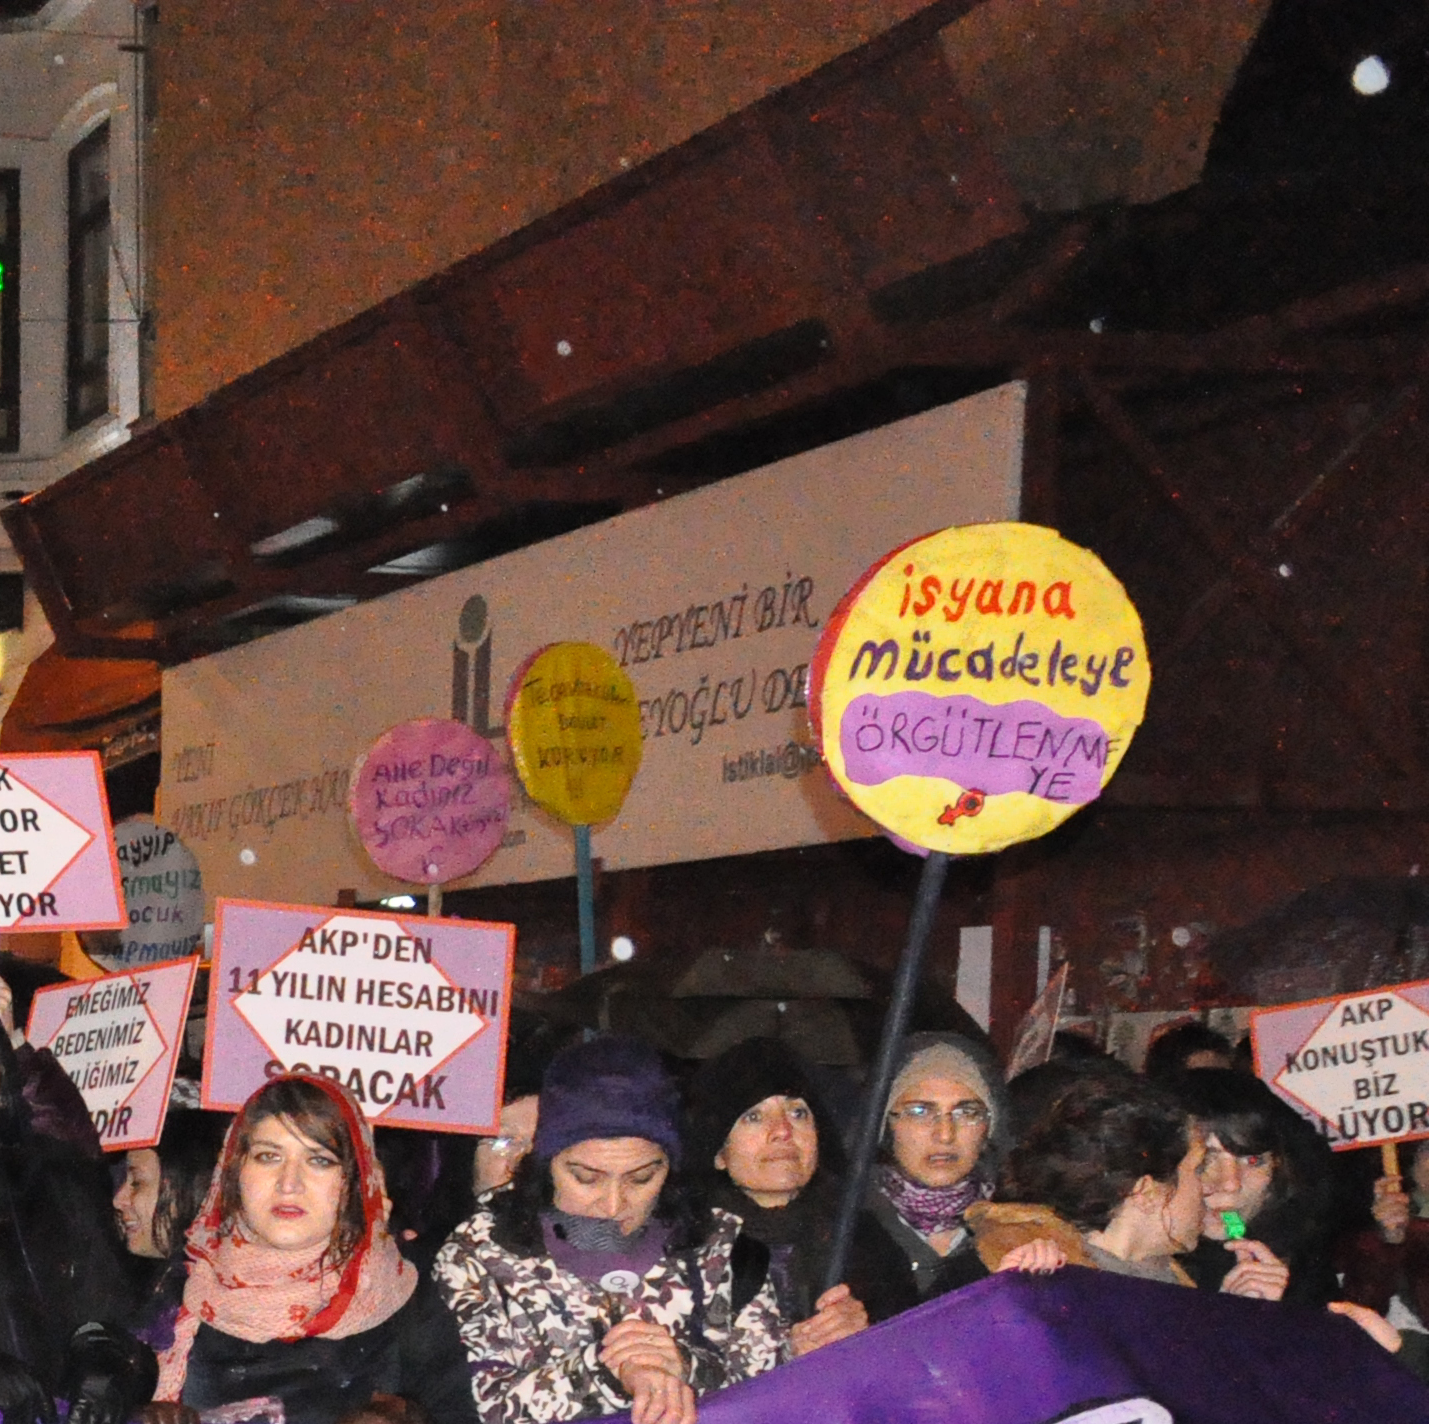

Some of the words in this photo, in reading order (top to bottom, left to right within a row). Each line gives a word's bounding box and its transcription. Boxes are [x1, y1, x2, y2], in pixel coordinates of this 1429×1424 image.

[848, 630, 1135, 696] mücadeleye
[1028, 765, 1076, 801] YE
[297, 926, 434, 965] AKP'DEN
[65, 978, 151, 1019] EMEĞİMİZ
[228, 966, 262, 996] 11
[271, 971, 346, 1003] YILIN
[356, 978, 499, 1018] HESABINI
[1340, 998, 1393, 1028] AKP
[54, 1018, 146, 1058] BEDENİMİZ
[285, 1018, 434, 1058] KADINLAR
[1354, 1070, 1400, 1101] BİZ
